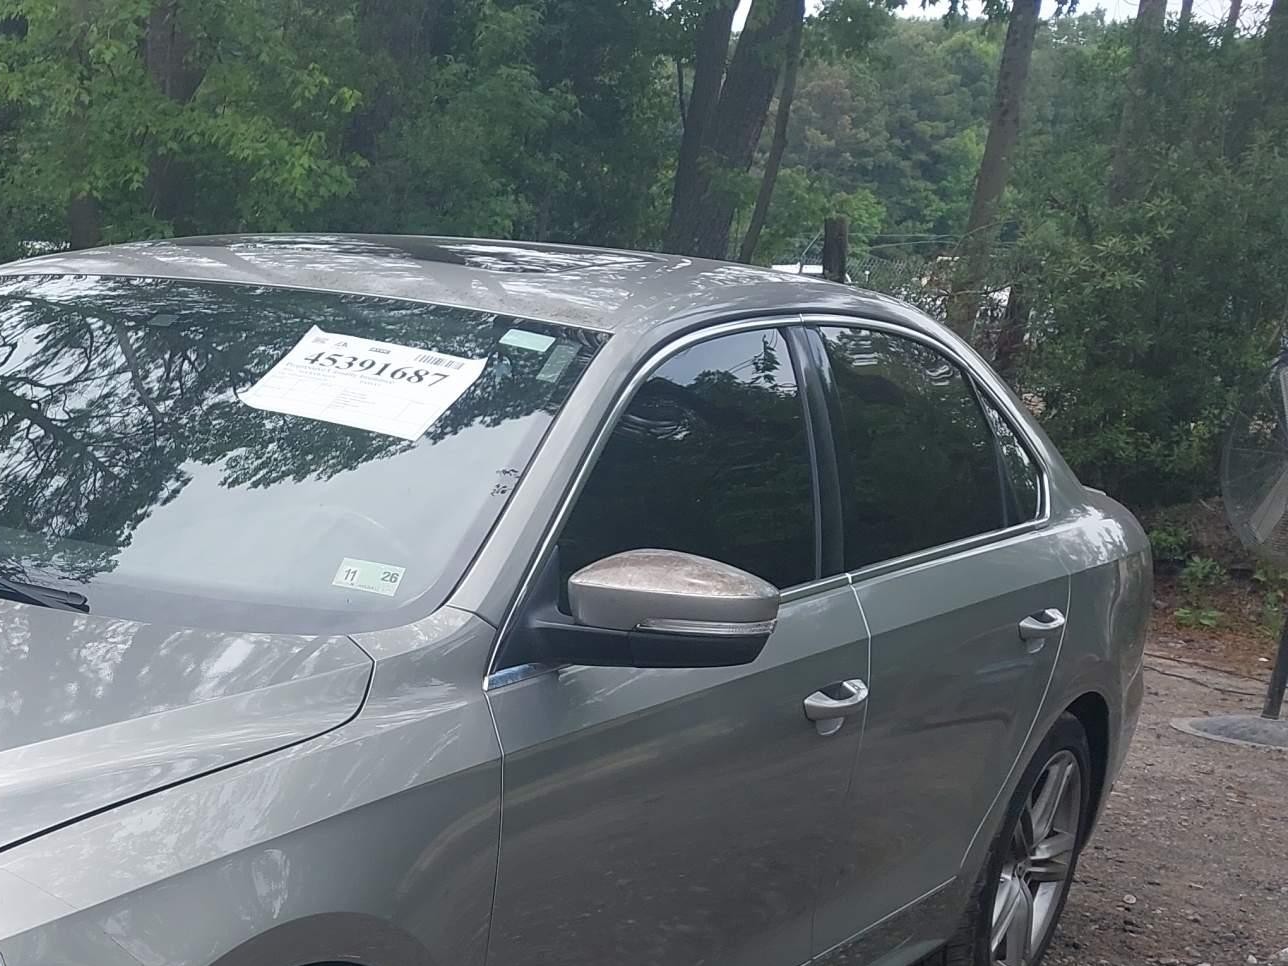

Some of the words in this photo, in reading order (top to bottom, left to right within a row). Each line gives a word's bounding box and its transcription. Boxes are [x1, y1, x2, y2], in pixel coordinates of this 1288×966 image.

[303, 351, 450, 388] 45391687
[344, 568, 358, 582] 11
[380, 571, 400, 584] 26
